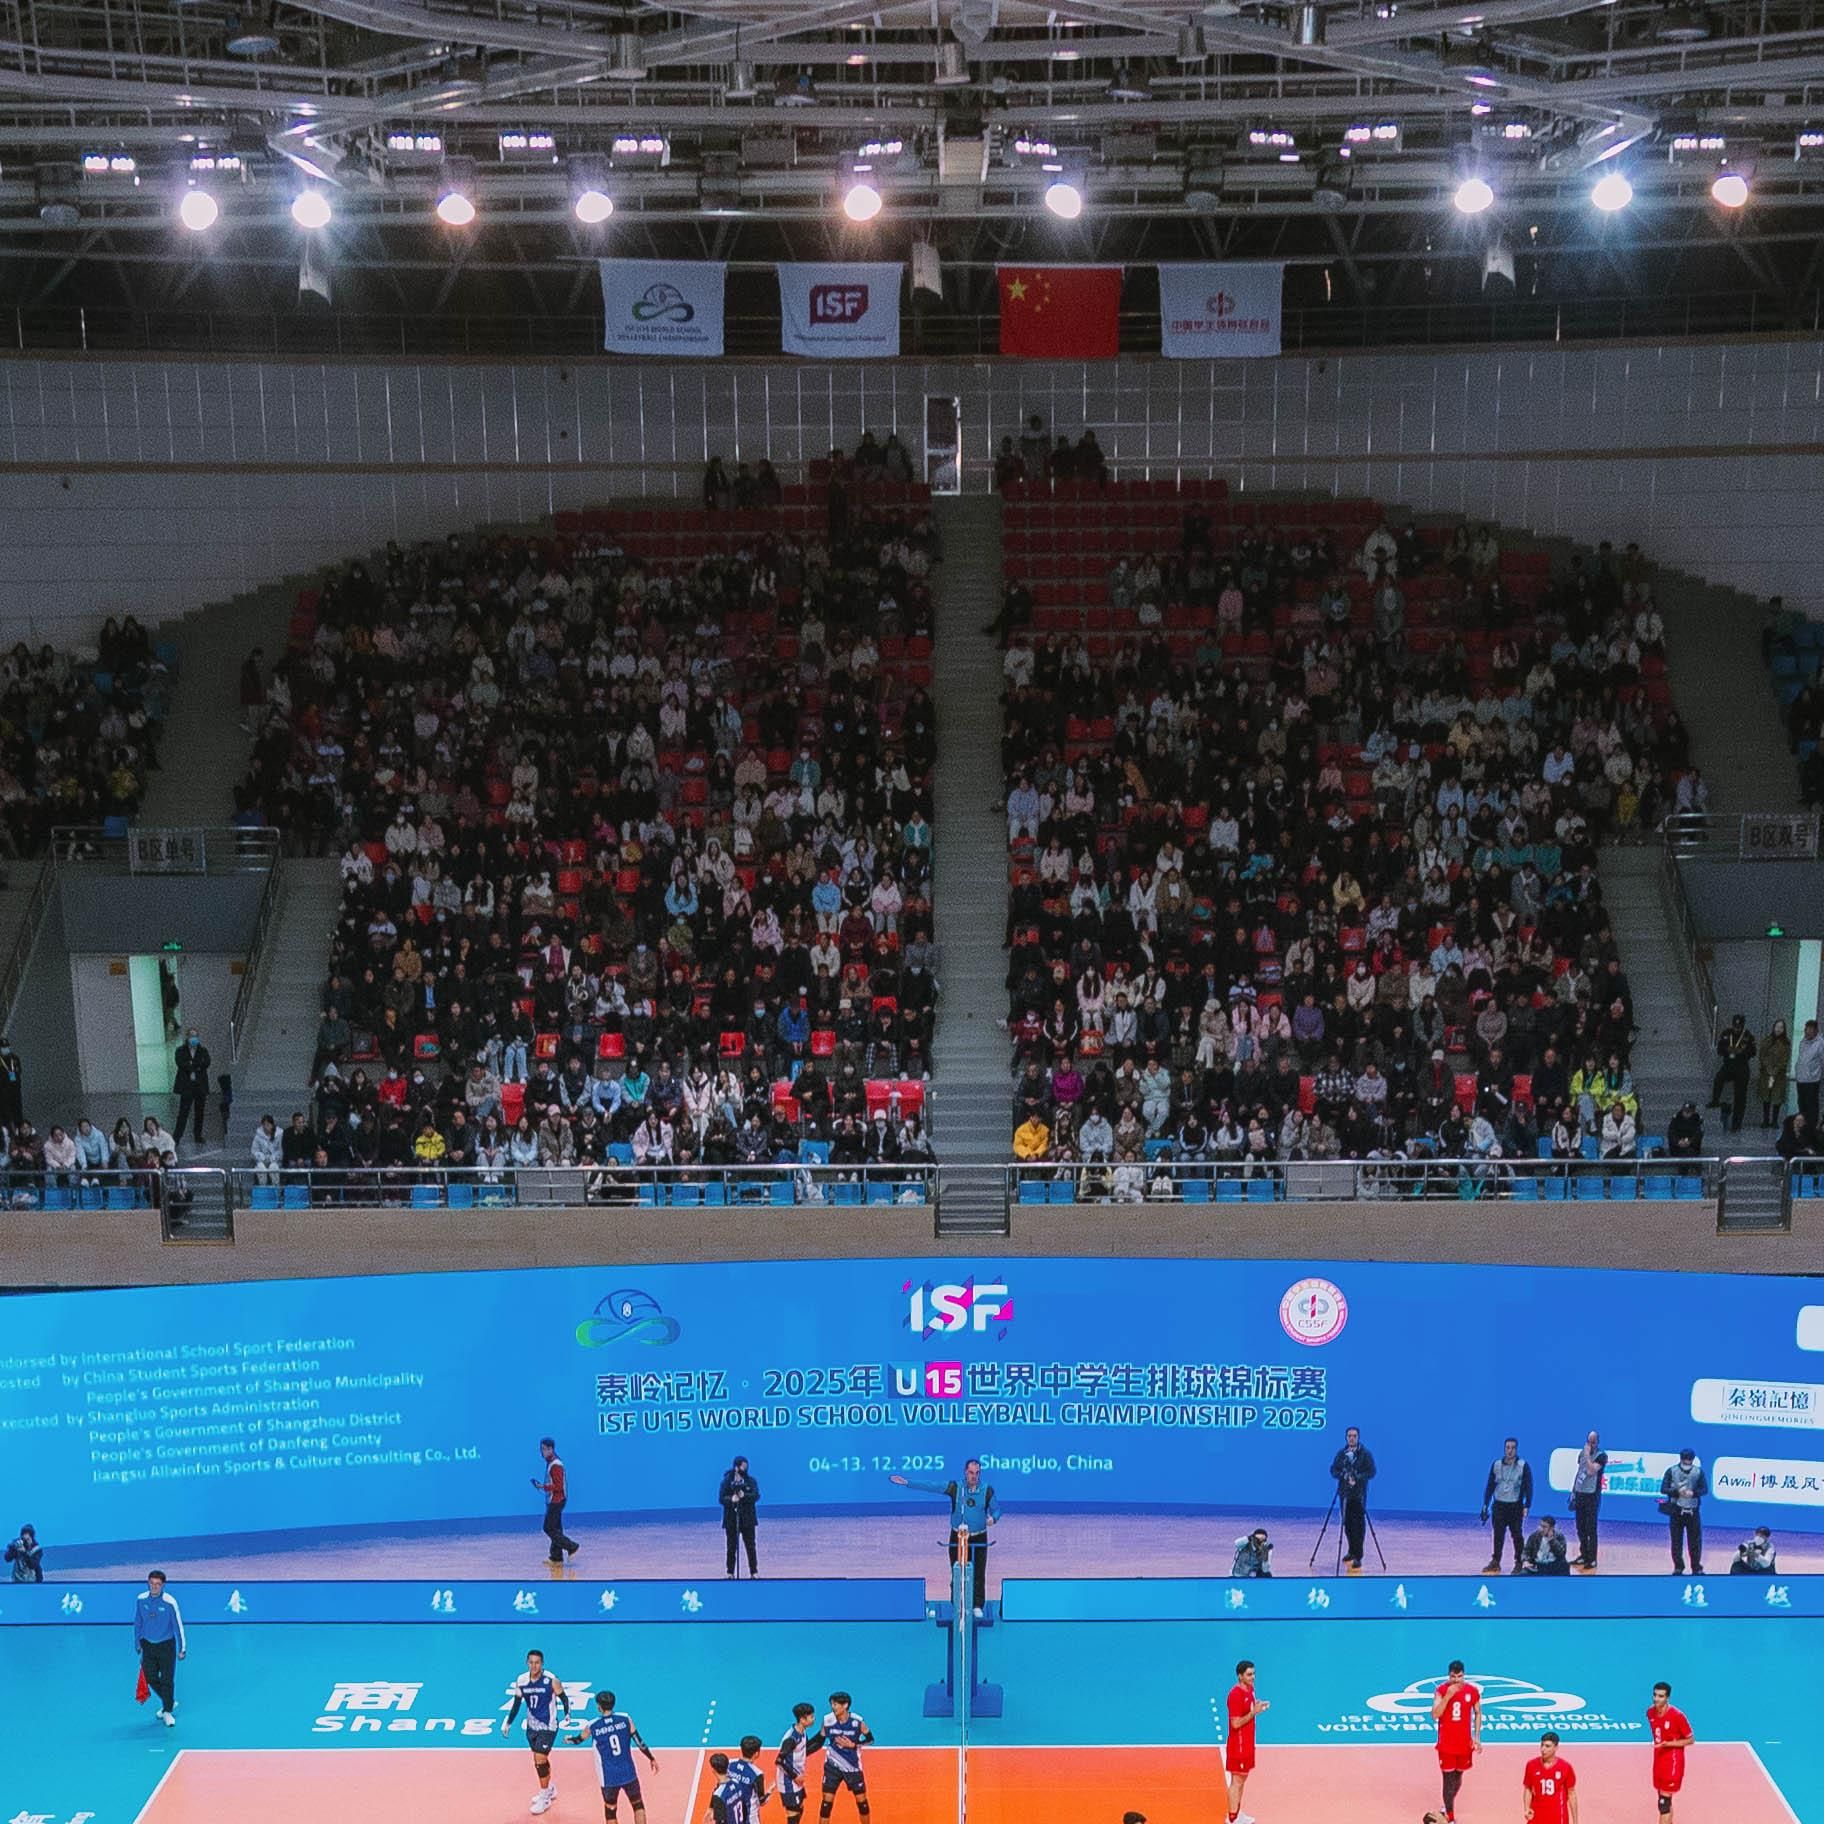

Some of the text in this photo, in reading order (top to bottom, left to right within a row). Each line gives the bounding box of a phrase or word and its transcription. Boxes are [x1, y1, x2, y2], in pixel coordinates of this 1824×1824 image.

[817, 291, 861, 317] ISF
[909, 1285, 1008, 1332] ISF
[60, 1353, 77, 1368] by
[81, 1347, 177, 1364] International
[181, 1343, 229, 1358] School
[233, 1341, 273, 1358] Sport
[277, 1337, 355, 1353] Federation
[62, 1374, 79, 1388] by
[83, 1371, 124, 1384] China
[128, 1367, 187, 1382] Student
[191, 1363, 237, 1379] Sports
[242, 1359, 320, 1374] Federation
[596, 1370, 729, 1404] 秦岭记忆
[763, 1364, 884, 1398] 2025年
[967, 1362, 1327, 1402] 世界中学生排球锦标赛
[87, 1372, 424, 1405] People's Government of Shangluo Municipality
[66, 1412, 84, 1427] by
[87, 1408, 157, 1424] Shangluo
[160, 1404, 208, 1420] Sports
[212, 1399, 320, 1416] Administration
[599, 1402, 1326, 1433] ISF U15 WORLD SCHOOL VOLLEYBALL CHAMPIONSHIP 2025
[89, 1412, 402, 1444] People's Government of Shangzhou District
[91, 1433, 382, 1464] People's Government of Danfeng County
[224, 1458, 271, 1476] Sports
[275, 1457, 286, 1469] &
[289, 1455, 343, 1469] Culture
[345, 1450, 422, 1467] Consulting
[454, 1446, 482, 1460] Ltd.
[901, 1455, 945, 1471] 2025
[979, 1453, 1113, 1473] Shangluo, China
[530, 1694, 539, 1709] 17
[1452, 1701, 1461, 1717] 8
[312, 1714, 591, 1735] Shanglo
[1318, 1722, 1439, 1733] VOLLEYBA
[1341, 1714, 1613, 1724] ISF U15 SCHOOL
[609, 1734, 622, 1756] 9
[1539, 1778, 1555, 1796] 19
